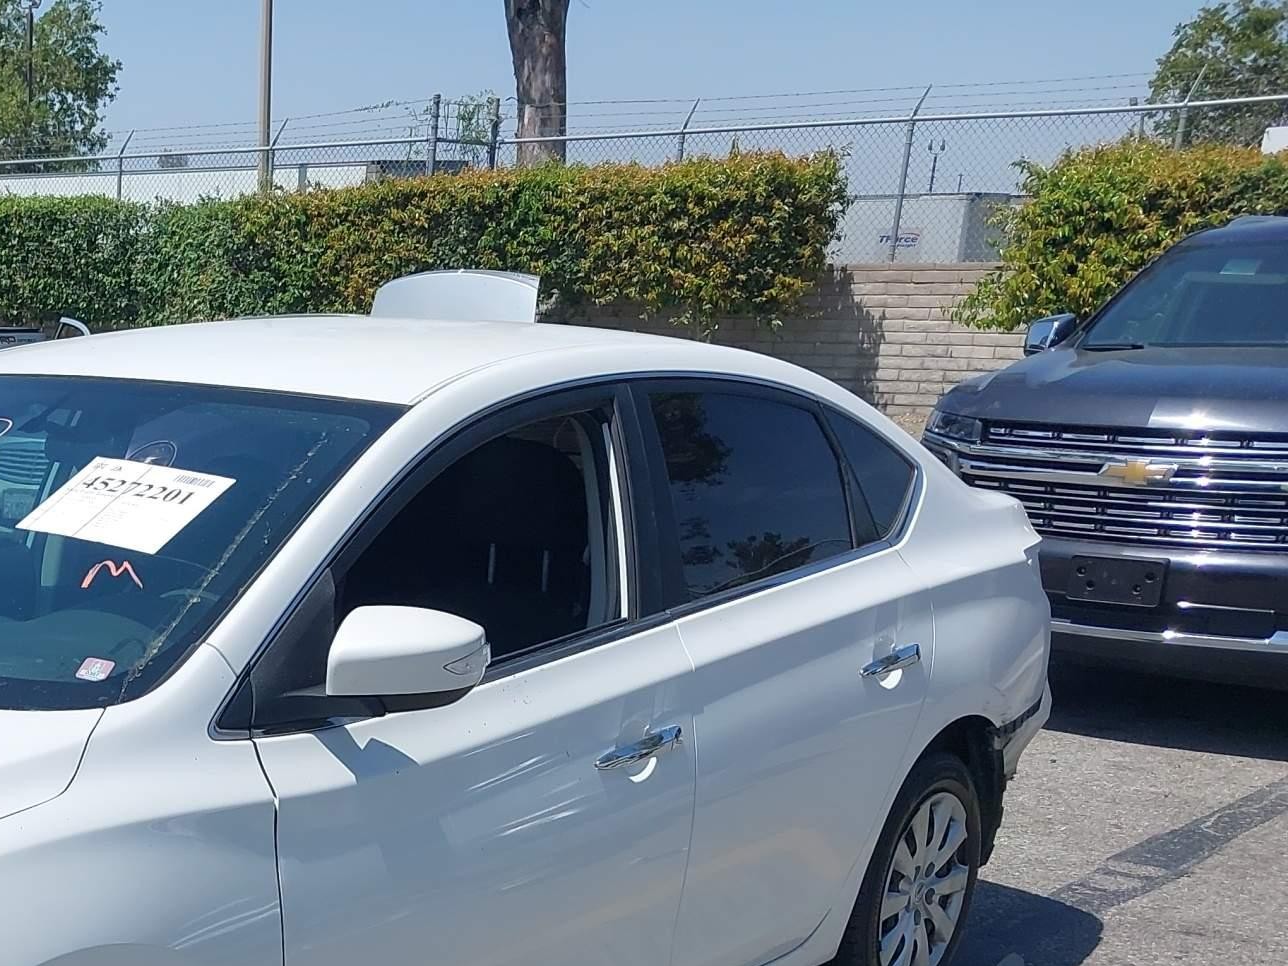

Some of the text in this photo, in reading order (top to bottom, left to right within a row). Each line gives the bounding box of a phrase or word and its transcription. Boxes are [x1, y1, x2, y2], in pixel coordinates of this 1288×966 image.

[879, 234, 919, 243] TFrce
[81, 475, 196, 505] 45272201
[80, 560, 144, 589] M
